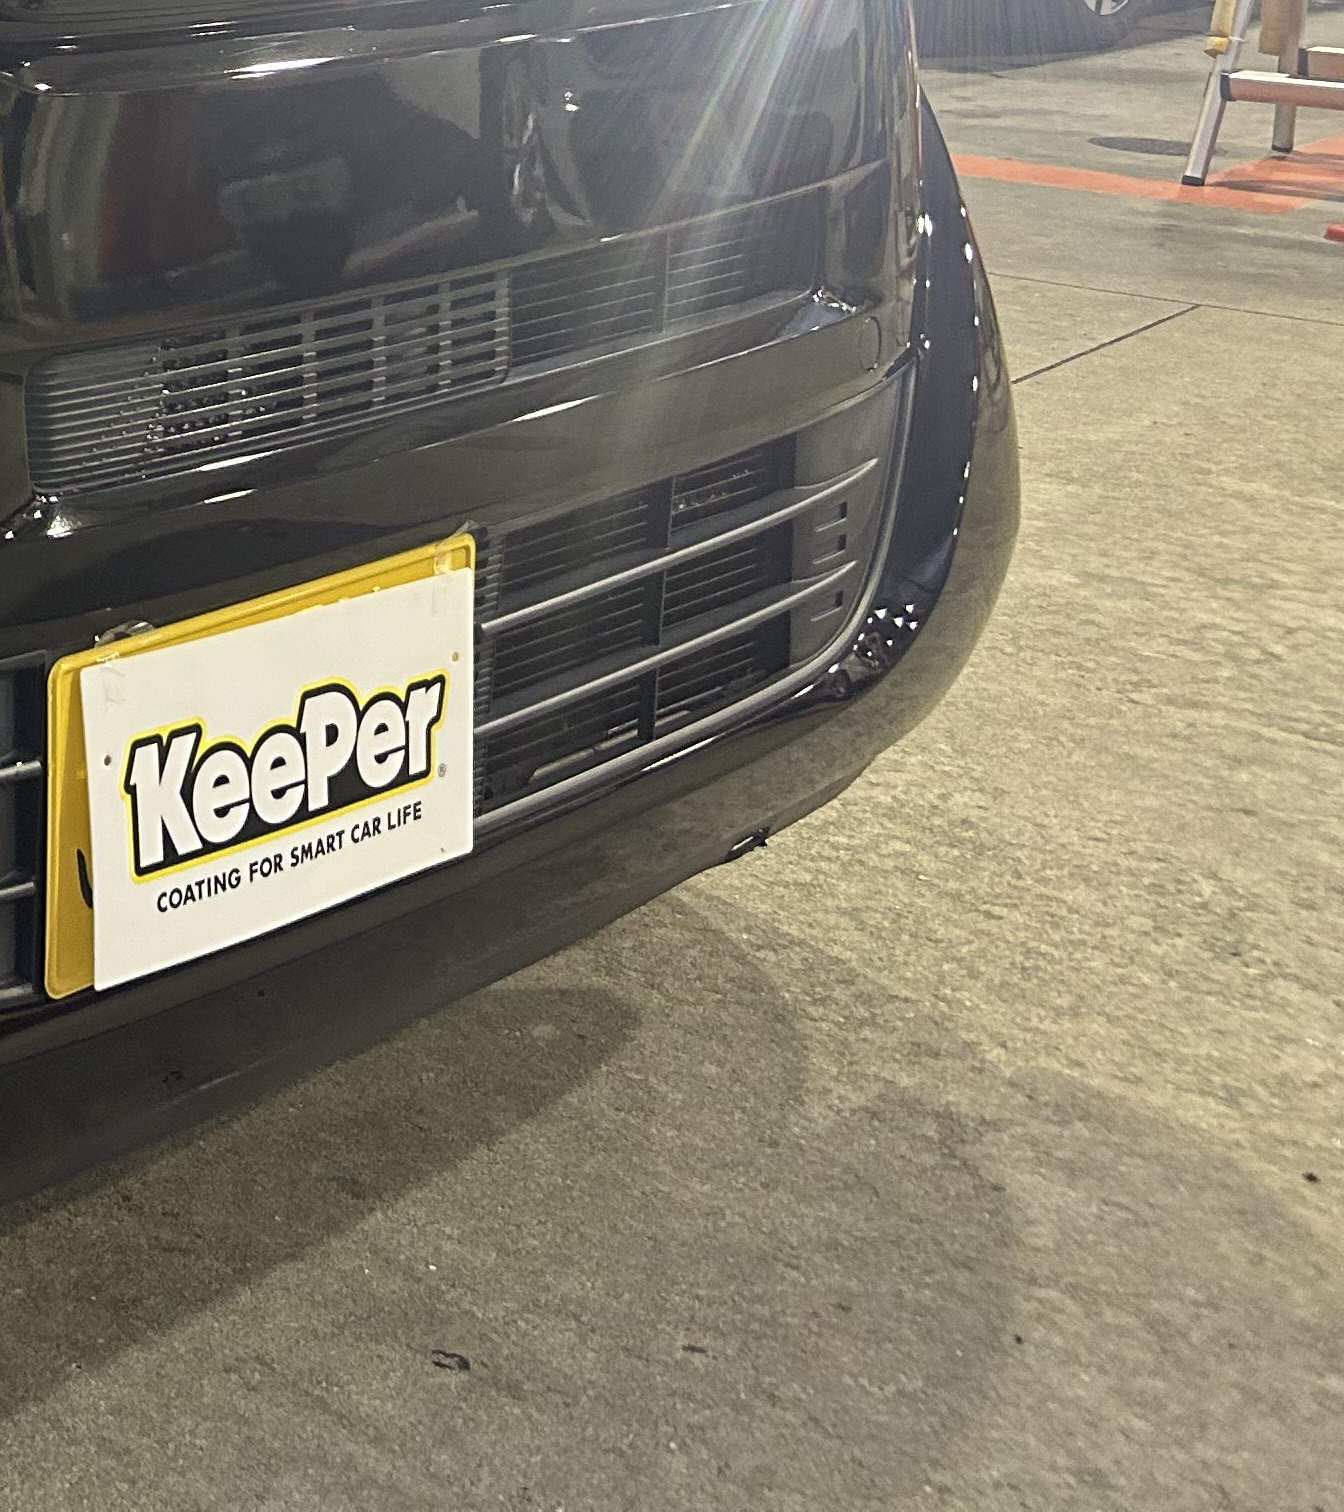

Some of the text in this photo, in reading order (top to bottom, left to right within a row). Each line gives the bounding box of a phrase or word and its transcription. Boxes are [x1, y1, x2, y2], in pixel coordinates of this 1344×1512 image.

[127, 675, 444, 871] KeePer
[156, 801, 423, 913] COATING FOR SMART CAR LIFE
